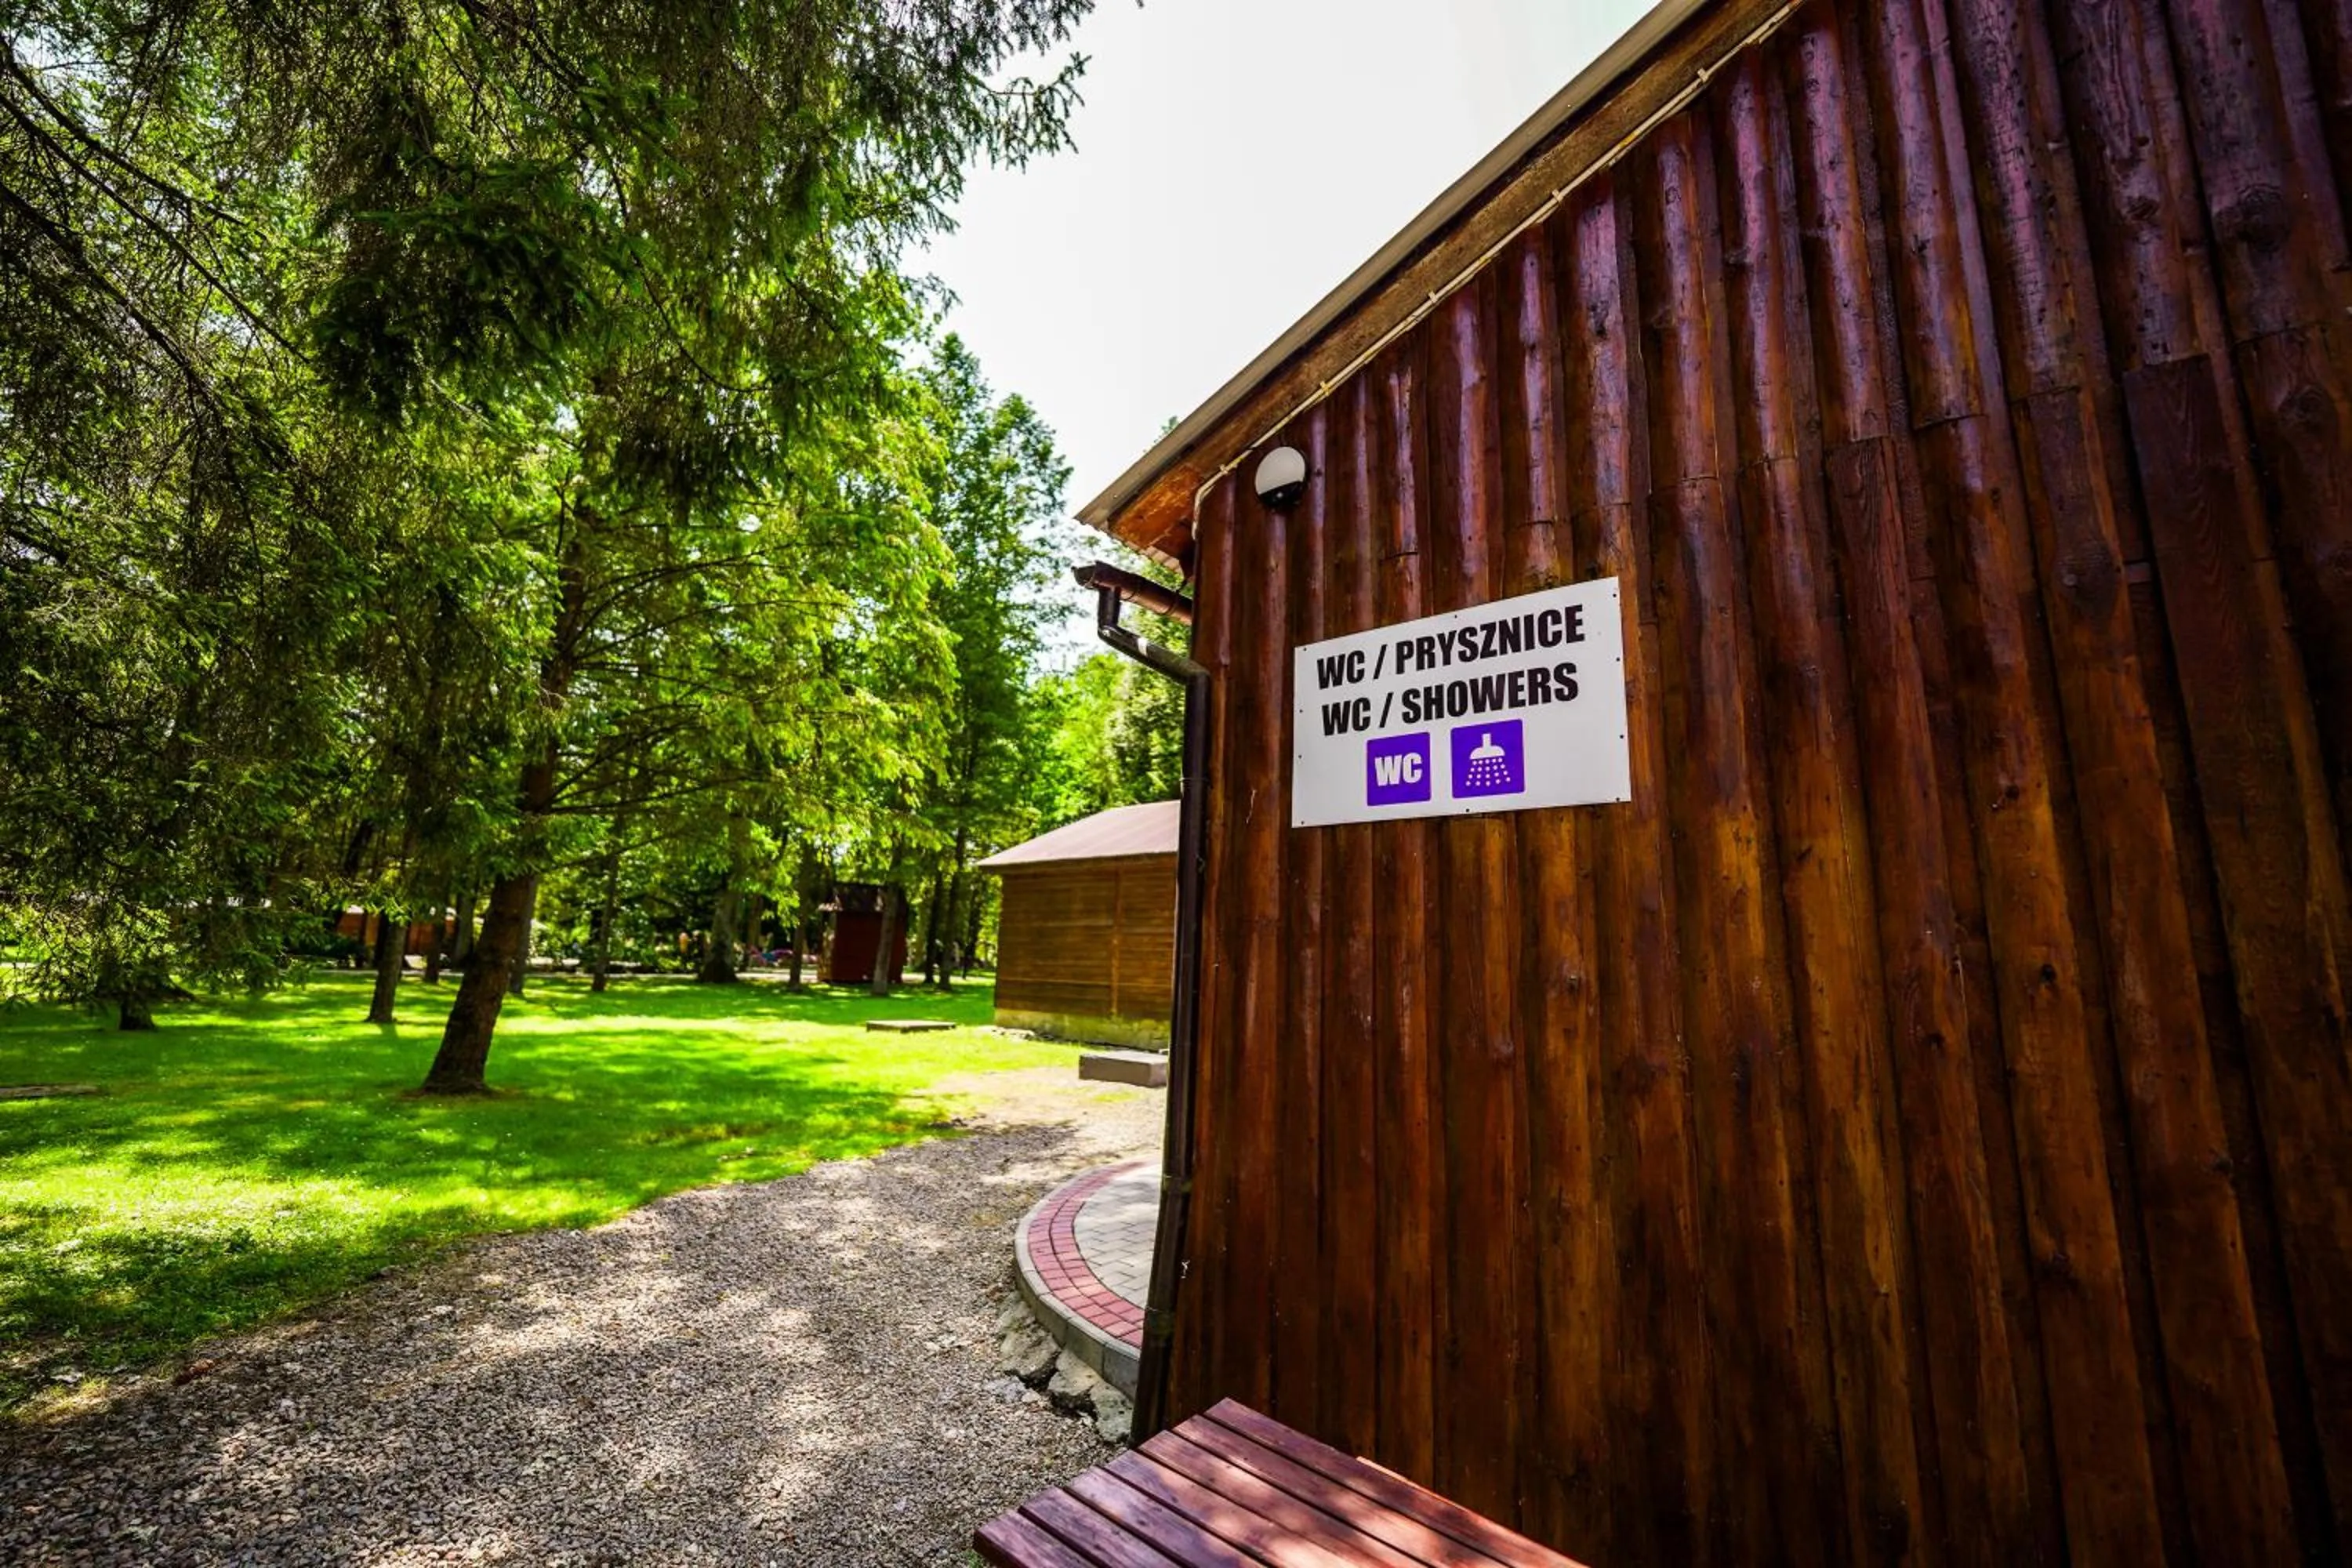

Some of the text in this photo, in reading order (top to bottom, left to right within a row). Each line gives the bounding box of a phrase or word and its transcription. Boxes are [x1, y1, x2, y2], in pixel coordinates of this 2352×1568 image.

[1317, 650, 1365, 690] WC
[1396, 604, 1585, 675] PRYSZNICE
[1322, 697, 1371, 736] WC
[1402, 662, 1579, 724] SHOWERS
[1374, 753, 1422, 786] WC
